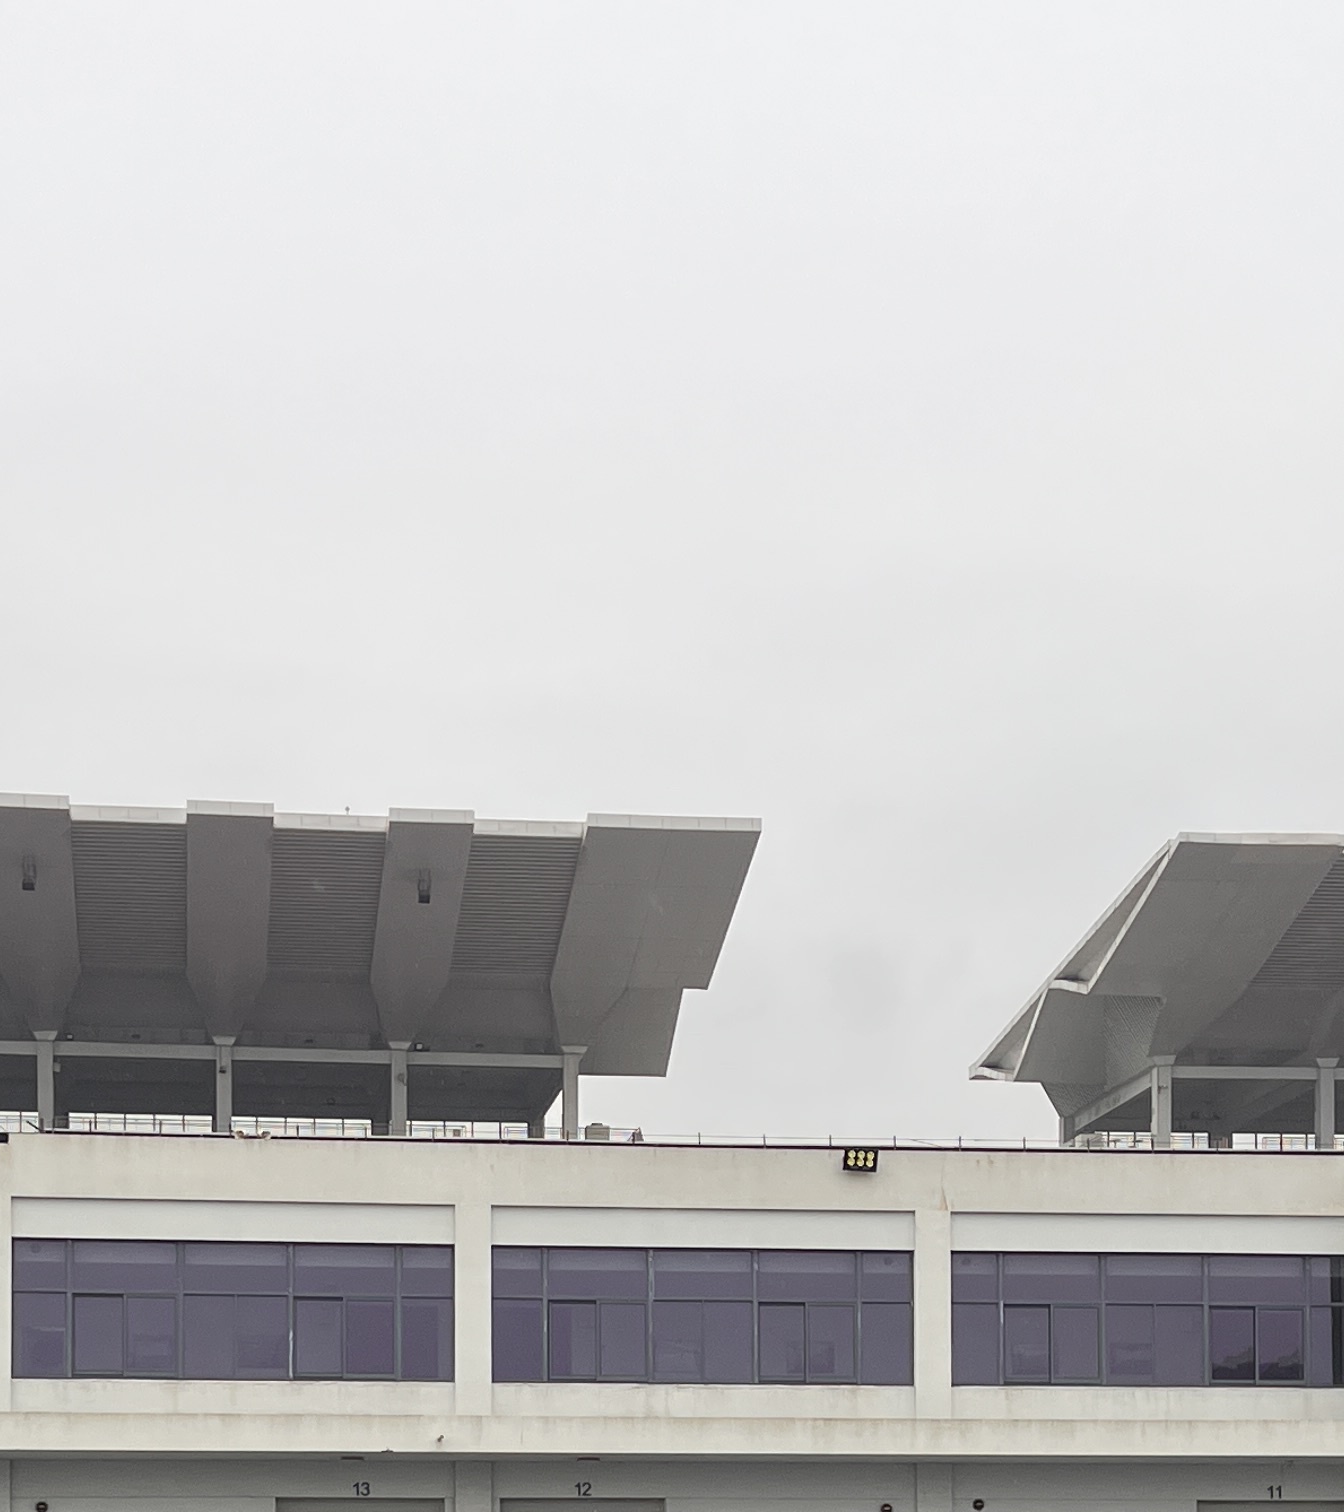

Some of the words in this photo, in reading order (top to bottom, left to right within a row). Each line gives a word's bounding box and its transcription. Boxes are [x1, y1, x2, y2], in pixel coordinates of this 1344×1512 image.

[352, 1481, 371, 1497] 13
[574, 1481, 592, 1497] 12
[1267, 1485, 1283, 1499] 11
